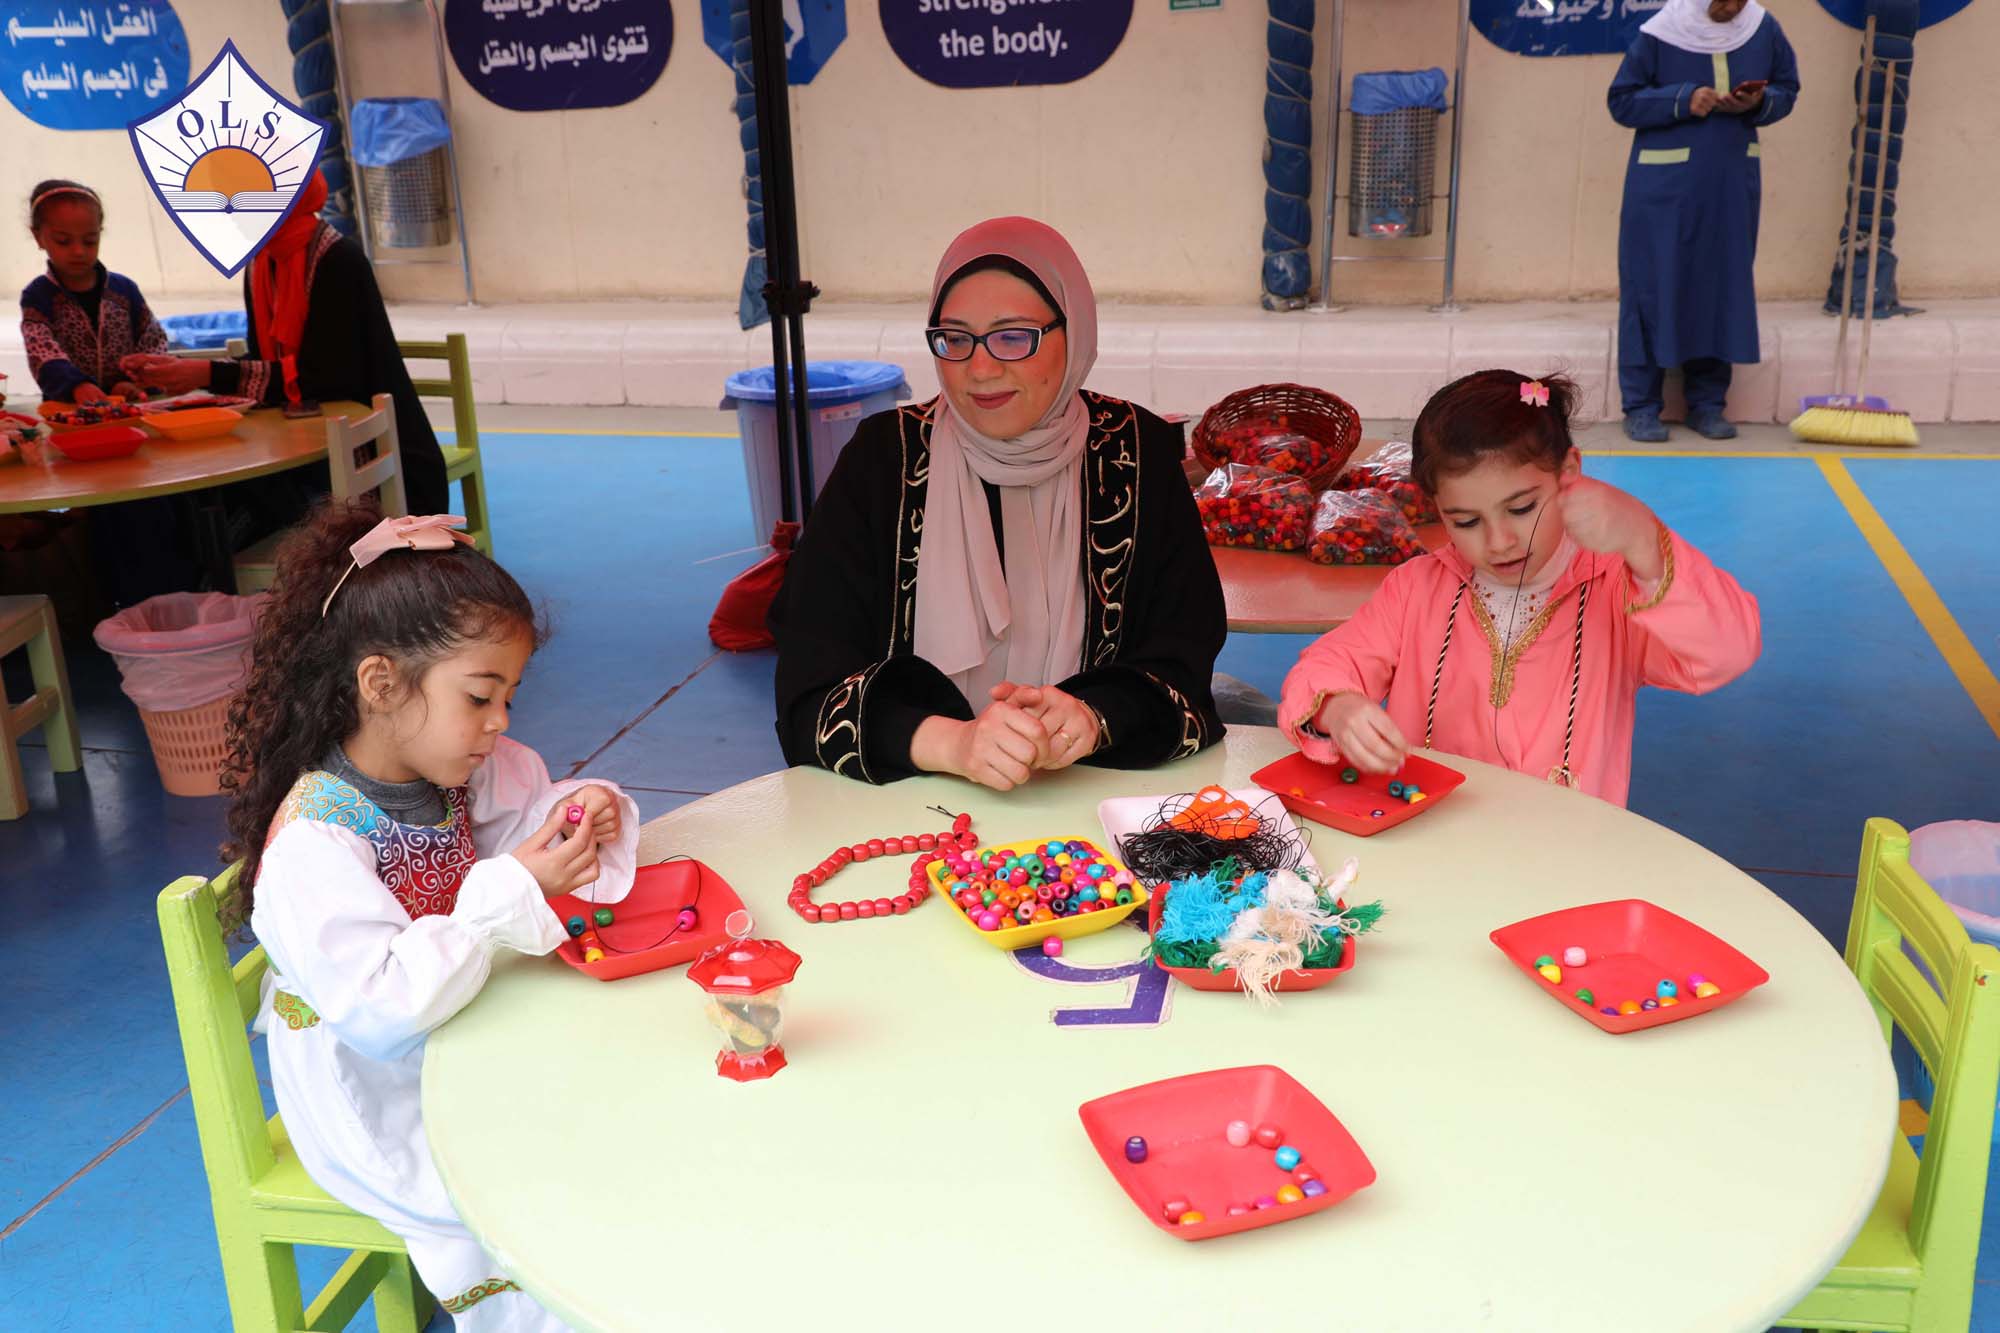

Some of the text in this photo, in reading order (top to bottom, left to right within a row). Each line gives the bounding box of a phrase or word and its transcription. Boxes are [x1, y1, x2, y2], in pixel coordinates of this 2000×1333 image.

[7, 3, 157, 47] العقل السليم
[939, 22, 1068, 58] the body.
[478, 40, 537, 75] والعقل
[540, 33, 597, 71] الجسم
[22, 62, 79, 99] السليم
[82, 61, 139, 99] الجسم
